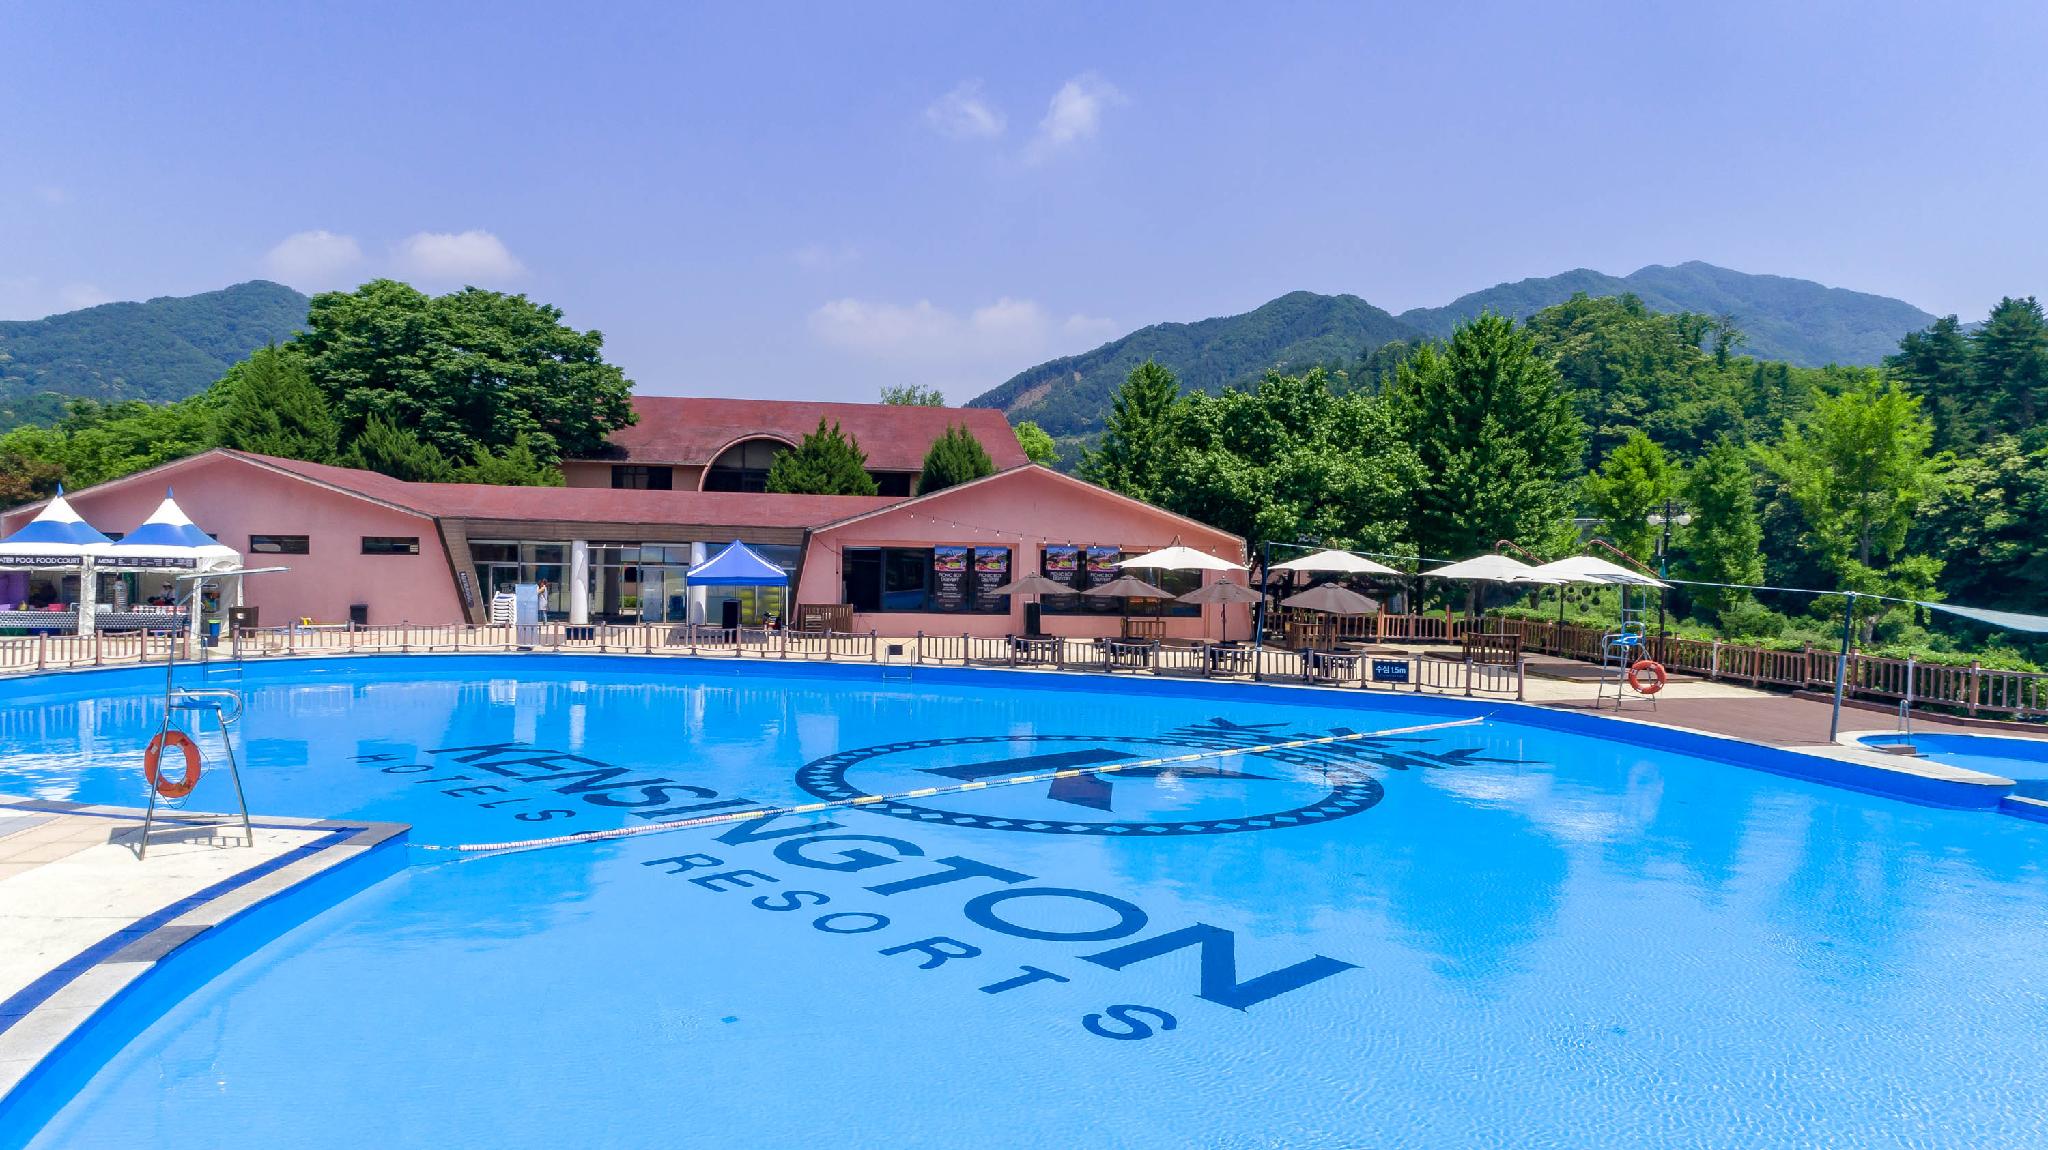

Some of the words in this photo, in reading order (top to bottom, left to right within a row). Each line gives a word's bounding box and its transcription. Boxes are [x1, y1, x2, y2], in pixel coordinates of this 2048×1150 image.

[1375, 665, 1390, 674] 수심
[1390, 666, 1407, 674] 1.5m
[346, 753, 576, 822] HOTELS
[641, 853, 1178, 1041] RESORTS
[423, 741, 1365, 1013] KENSINGTON
